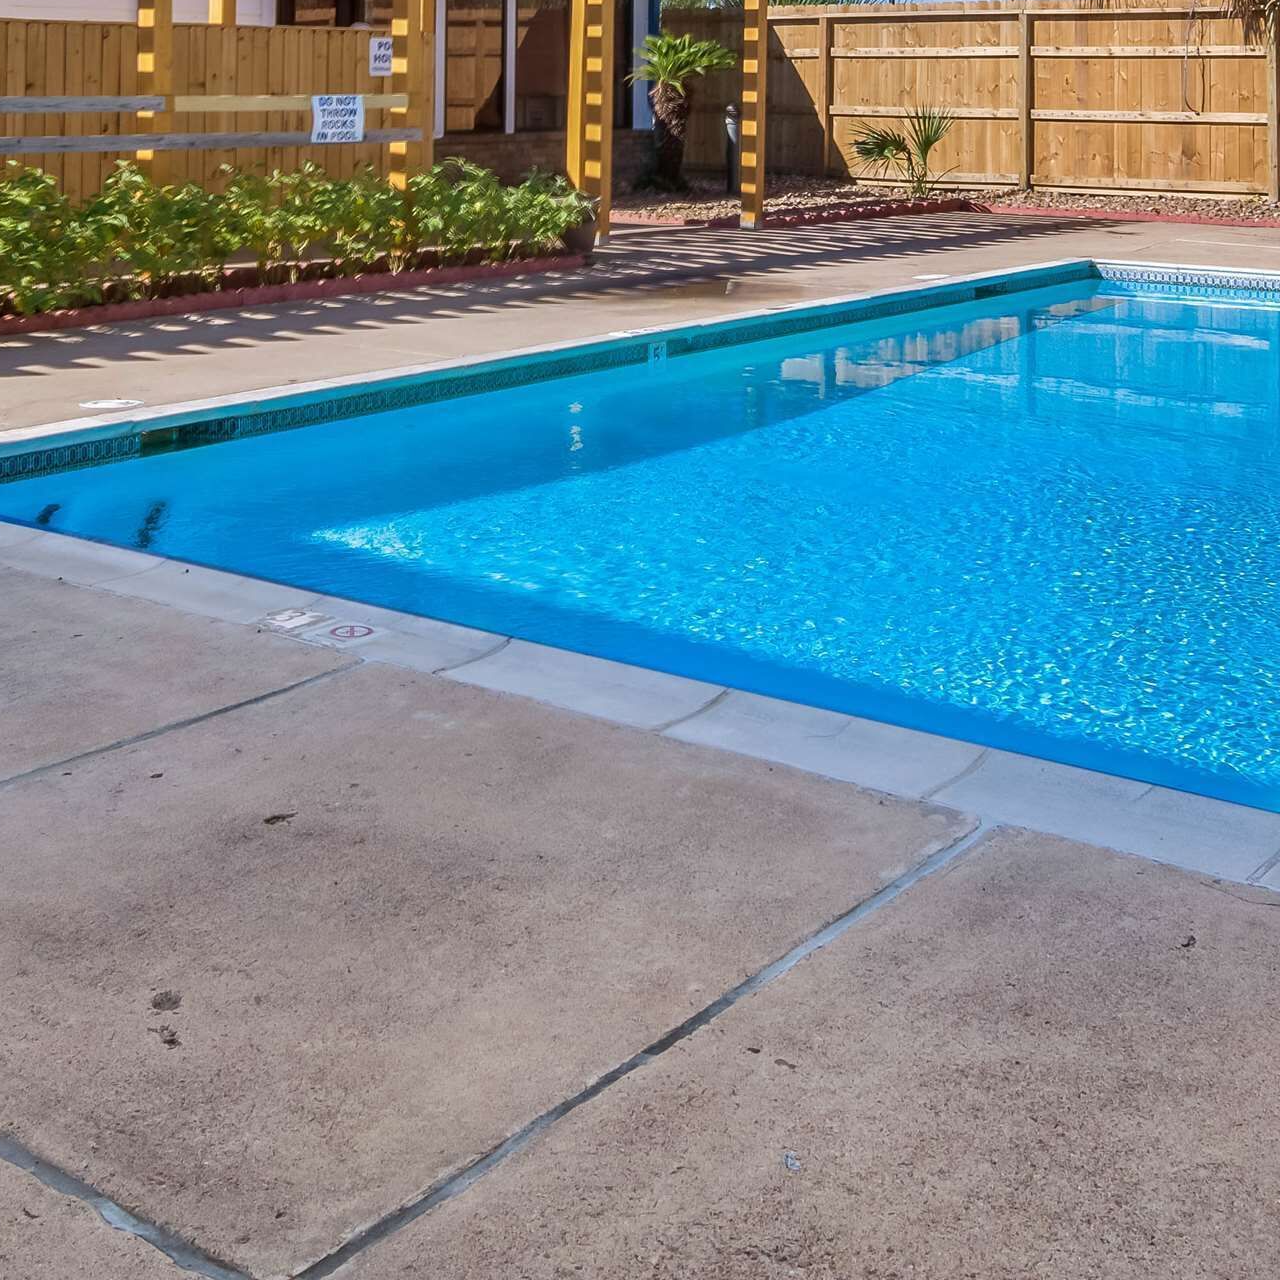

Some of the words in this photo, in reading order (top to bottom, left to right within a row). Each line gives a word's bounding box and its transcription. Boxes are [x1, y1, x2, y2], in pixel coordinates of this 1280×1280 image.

[318, 96, 334, 108] DO
[335, 95, 357, 107] NOT
[320, 107, 358, 119] THROW
[320, 119, 356, 130] ROCKS
[315, 130, 329, 141] IN
[330, 130, 360, 141] POOL
